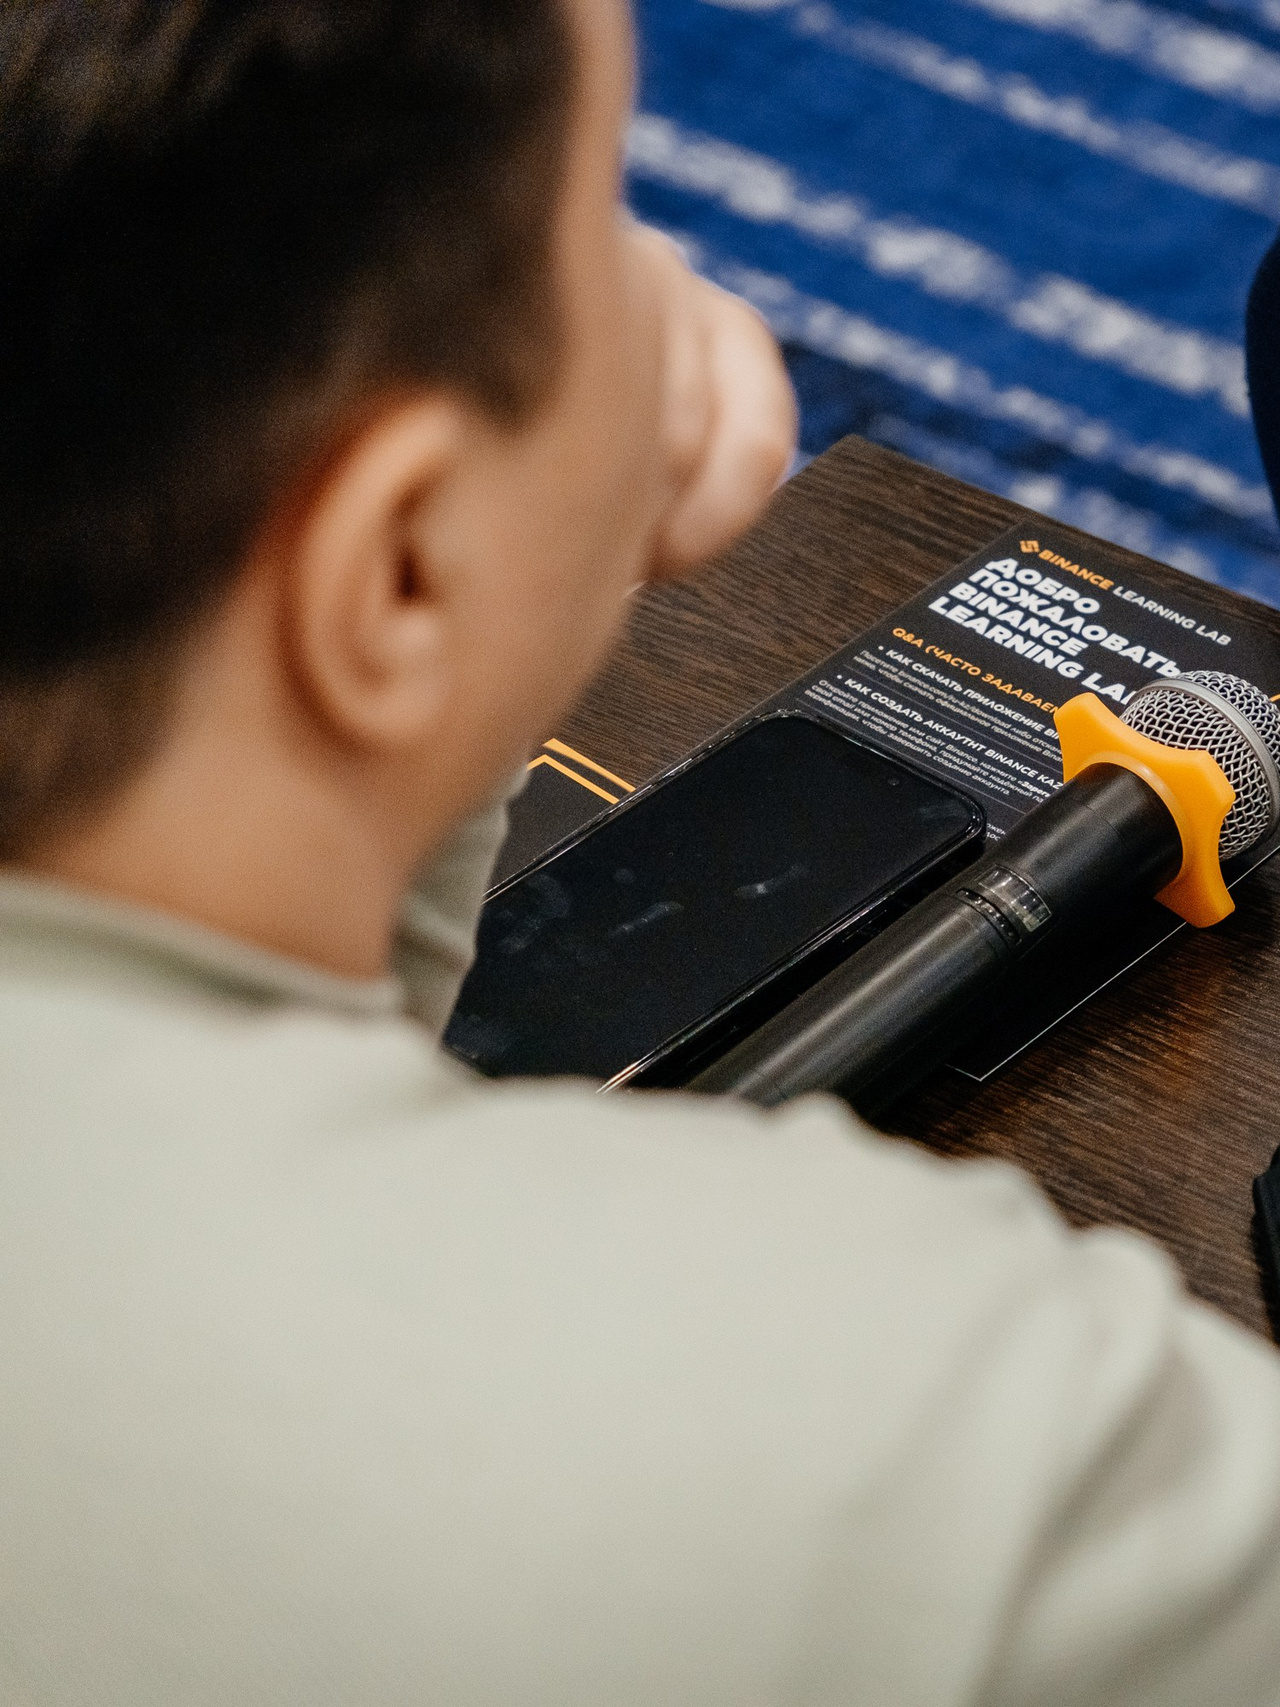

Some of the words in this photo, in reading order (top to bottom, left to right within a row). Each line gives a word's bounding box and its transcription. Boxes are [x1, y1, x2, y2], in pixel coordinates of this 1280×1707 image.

[948, 581, 1089, 657] BINANCE
[968, 568, 1181, 679] ПОЖАЛОВАТЬ
[984, 557, 1101, 614] ДОБРО
[1038, 549, 1115, 590] BINANCE
[1112, 586, 1197, 629] LEARNING
[1195, 625, 1232, 646] LAB
[892, 627, 924, 648] Q&A
[924, 645, 982, 676] (ЧАСТО
[928, 595, 1085, 679] LEARNING
[844, 678, 872, 696] КАК
[870, 692, 924, 722] СОЗДАТЬ
[984, 748, 1039, 778] BINANCE
[885, 649, 914, 666] КАК
[911, 662, 963, 692] СКАЧАТЬ
[962, 688, 1046, 732] ПРИЛОЖЕНИЕ
